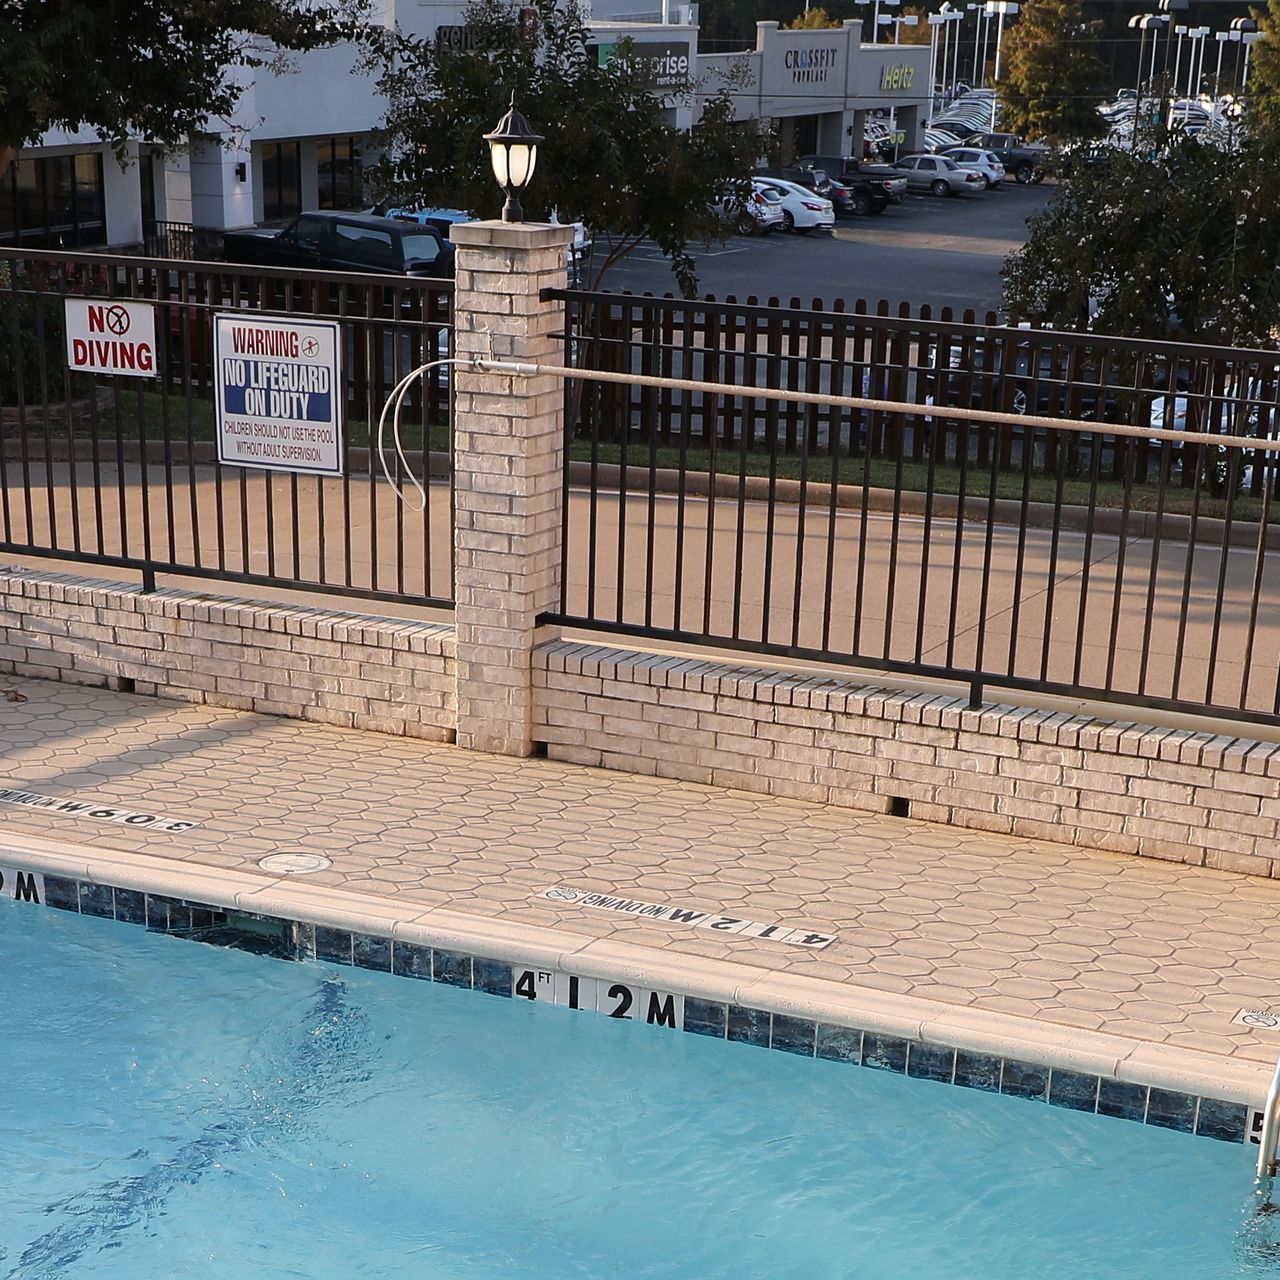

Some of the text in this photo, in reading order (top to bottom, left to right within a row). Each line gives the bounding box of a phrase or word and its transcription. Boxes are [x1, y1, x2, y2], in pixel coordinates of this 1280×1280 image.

[882, 64, 915, 90] Hertz
[73, 339, 153, 370] DIVING
[232, 327, 298, 358] WARNING
[225, 359, 329, 393] NO LIFEGUARD
[245, 388, 309, 419] ON DUTY
[224, 420, 334, 444] CHILDREN SHOULD NOT USE THE POOL
[236, 441, 262, 456] WITHOUT
[263, 443, 281, 458] ADULT
[582, 895, 642, 913] DIVING
[641, 905, 665, 918] NO
